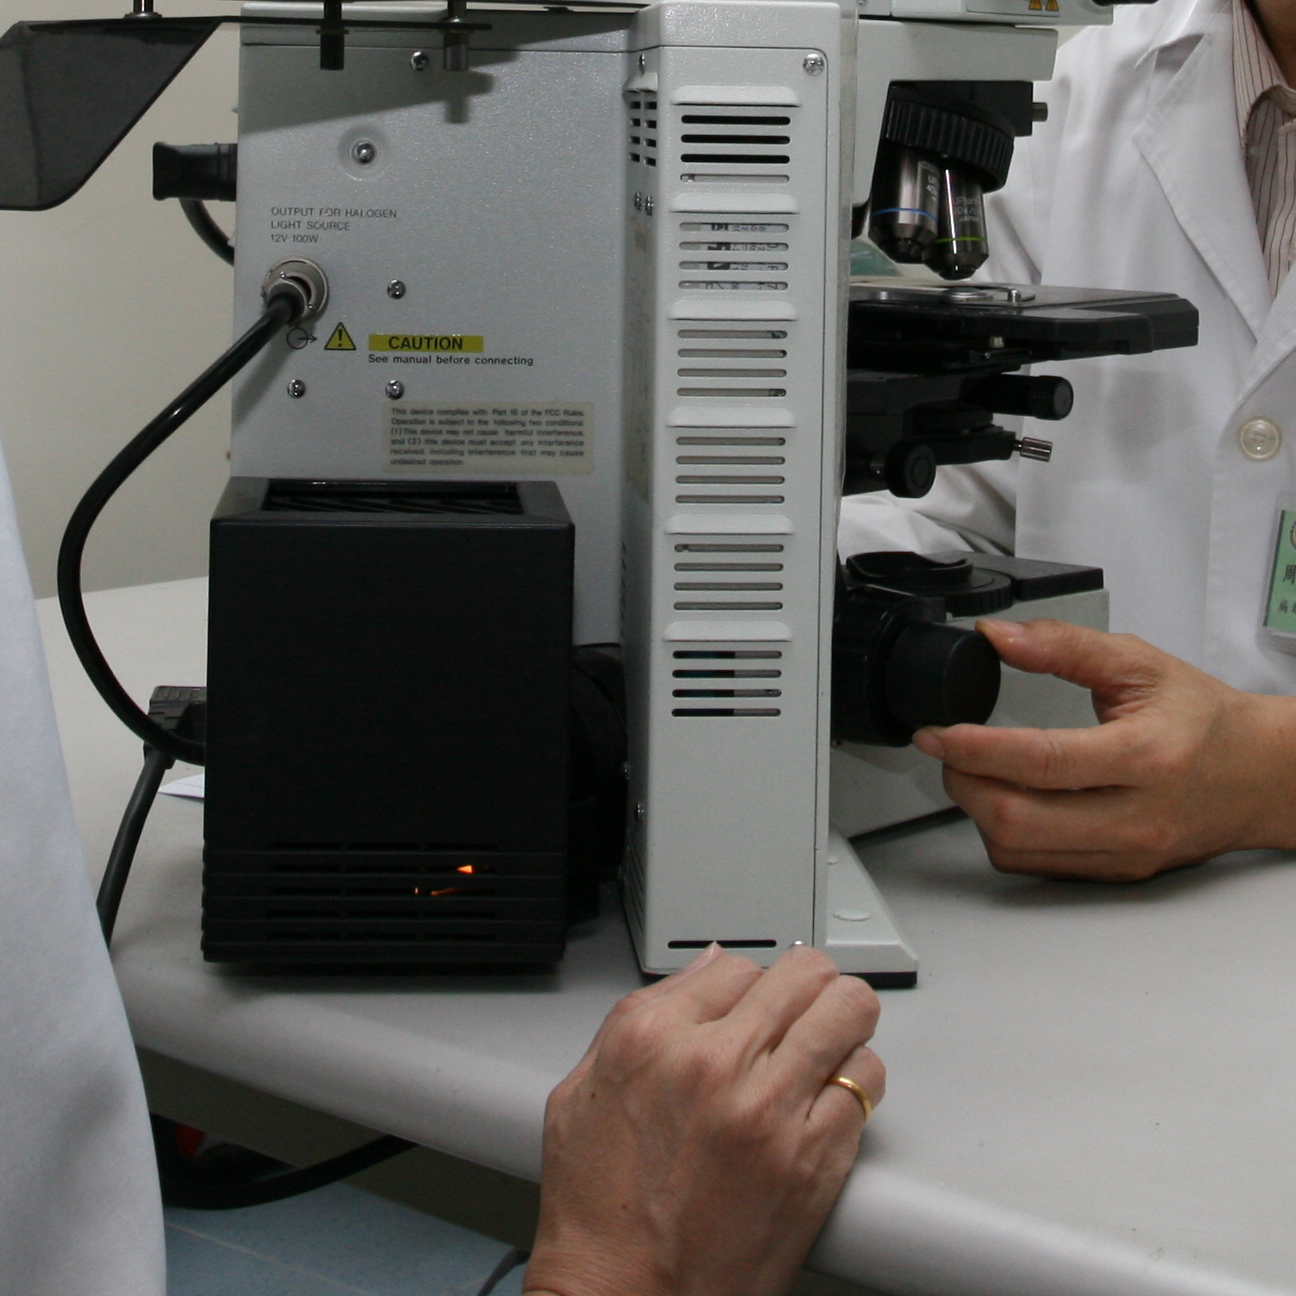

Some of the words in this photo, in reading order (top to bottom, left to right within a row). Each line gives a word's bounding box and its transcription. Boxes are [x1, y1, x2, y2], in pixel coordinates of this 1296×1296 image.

[271, 206, 315, 217] OUTPUT
[319, 208, 341, 217] FOR
[345, 208, 397, 218] HALOGEN
[270, 220, 302, 230] LIGHT
[306, 221, 351, 231] SOURCE
[270, 234, 288, 243] 12V
[292, 234, 319, 243] 100W
[388, 336, 463, 351] CAUTION
[368, 354, 389, 364] See
[393, 354, 432, 364] manual
[436, 355, 470, 365] before
[474, 356, 534, 367] connecting
[392, 408, 407, 416] This
[410, 408, 434, 416] device
[436, 408, 470, 417] complies
[472, 408, 488, 416] with
[492, 408, 507, 416] Part
[510, 408, 518, 416] 15
[521, 408, 529, 416] of
[531, 408, 543, 416] the
[544, 408, 560, 416] FCC
[390, 418, 427, 427] Operation
[429, 418, 436, 426] is
[438, 418, 465, 427] subject
[467, 418, 475, 426] to
[477, 418, 489, 426] the
[493, 418, 526, 427] following
[420, 428, 443, 436] device
[445, 429, 460, 437] may
[462, 428, 475, 436] not
[505, 428, 534, 436] harmful
[390, 438, 405, 446] and
[407, 438, 421, 446] (2)
[424, 438, 438, 446] this
[440, 438, 466, 446] device
[468, 438, 487, 446] must
[489, 439, 517, 447] accept
[520, 439, 534, 447] any
[537, 439, 584, 447] interference
[429, 448, 465, 457] including
[467, 448, 516, 456] interference
[520, 448, 537, 456] that
[540, 449, 556, 457] may
[559, 449, 584, 457] cause
